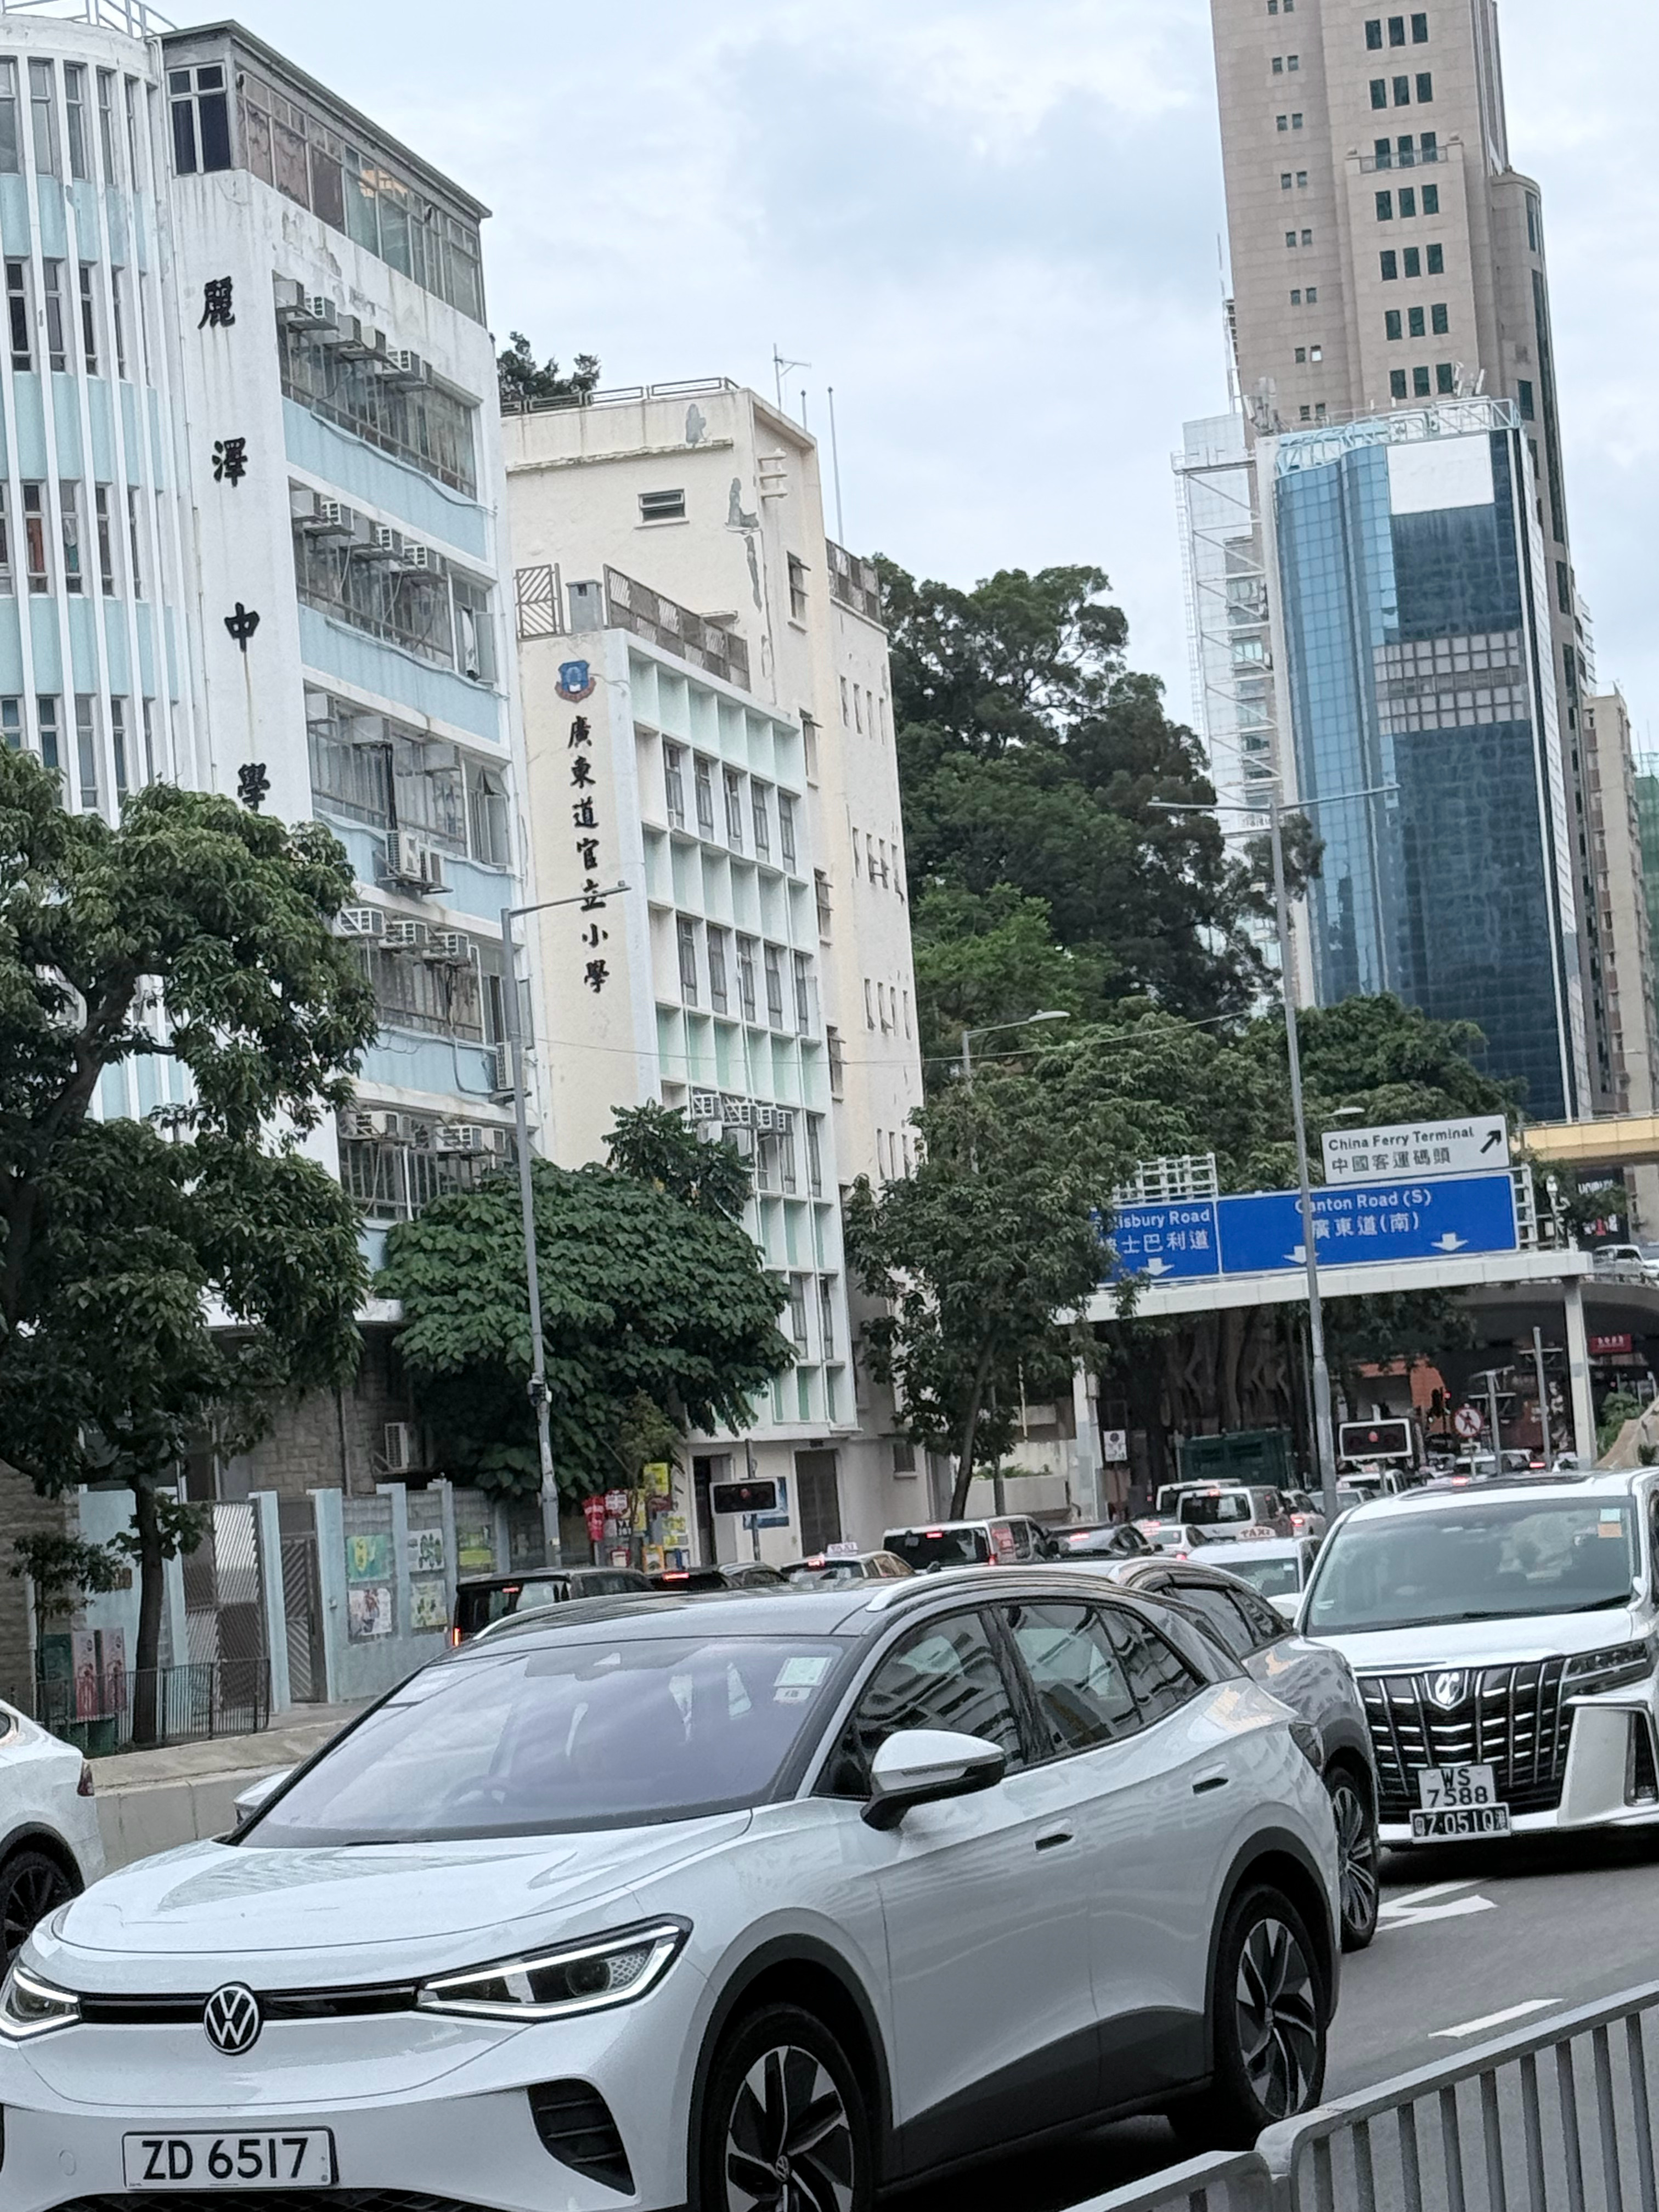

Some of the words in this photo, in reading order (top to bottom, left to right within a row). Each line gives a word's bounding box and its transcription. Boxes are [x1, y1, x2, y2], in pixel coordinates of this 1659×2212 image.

[198, 275, 271, 812] 麗澤中學
[567, 715, 610, 994] 廣東道官立小學
[1328, 1137, 1369, 1151] China
[1373, 1135, 1409, 1147] Ferry
[1412, 1126, 1474, 1143] Terminal
[1331, 1147, 1451, 1174] 中國客運碼頭
[1357, 1192, 1398, 1207] Road
[1403, 1188, 1431, 1207] (S)
[1094, 1214, 1165, 1231] isbury
[1169, 1209, 1211, 1226] Road
[1311, 1211, 1419, 1239] 廣東道(南)
[1240, 1528, 1270, 1538] TAXI
[1441, 1768, 1471, 1788] WS
[1427, 1786, 1488, 1808] 7588
[205, 1986, 259, 2053] VW
[142, 2140, 193, 2180] ZD
[208, 2137, 309, 2179] 6517
